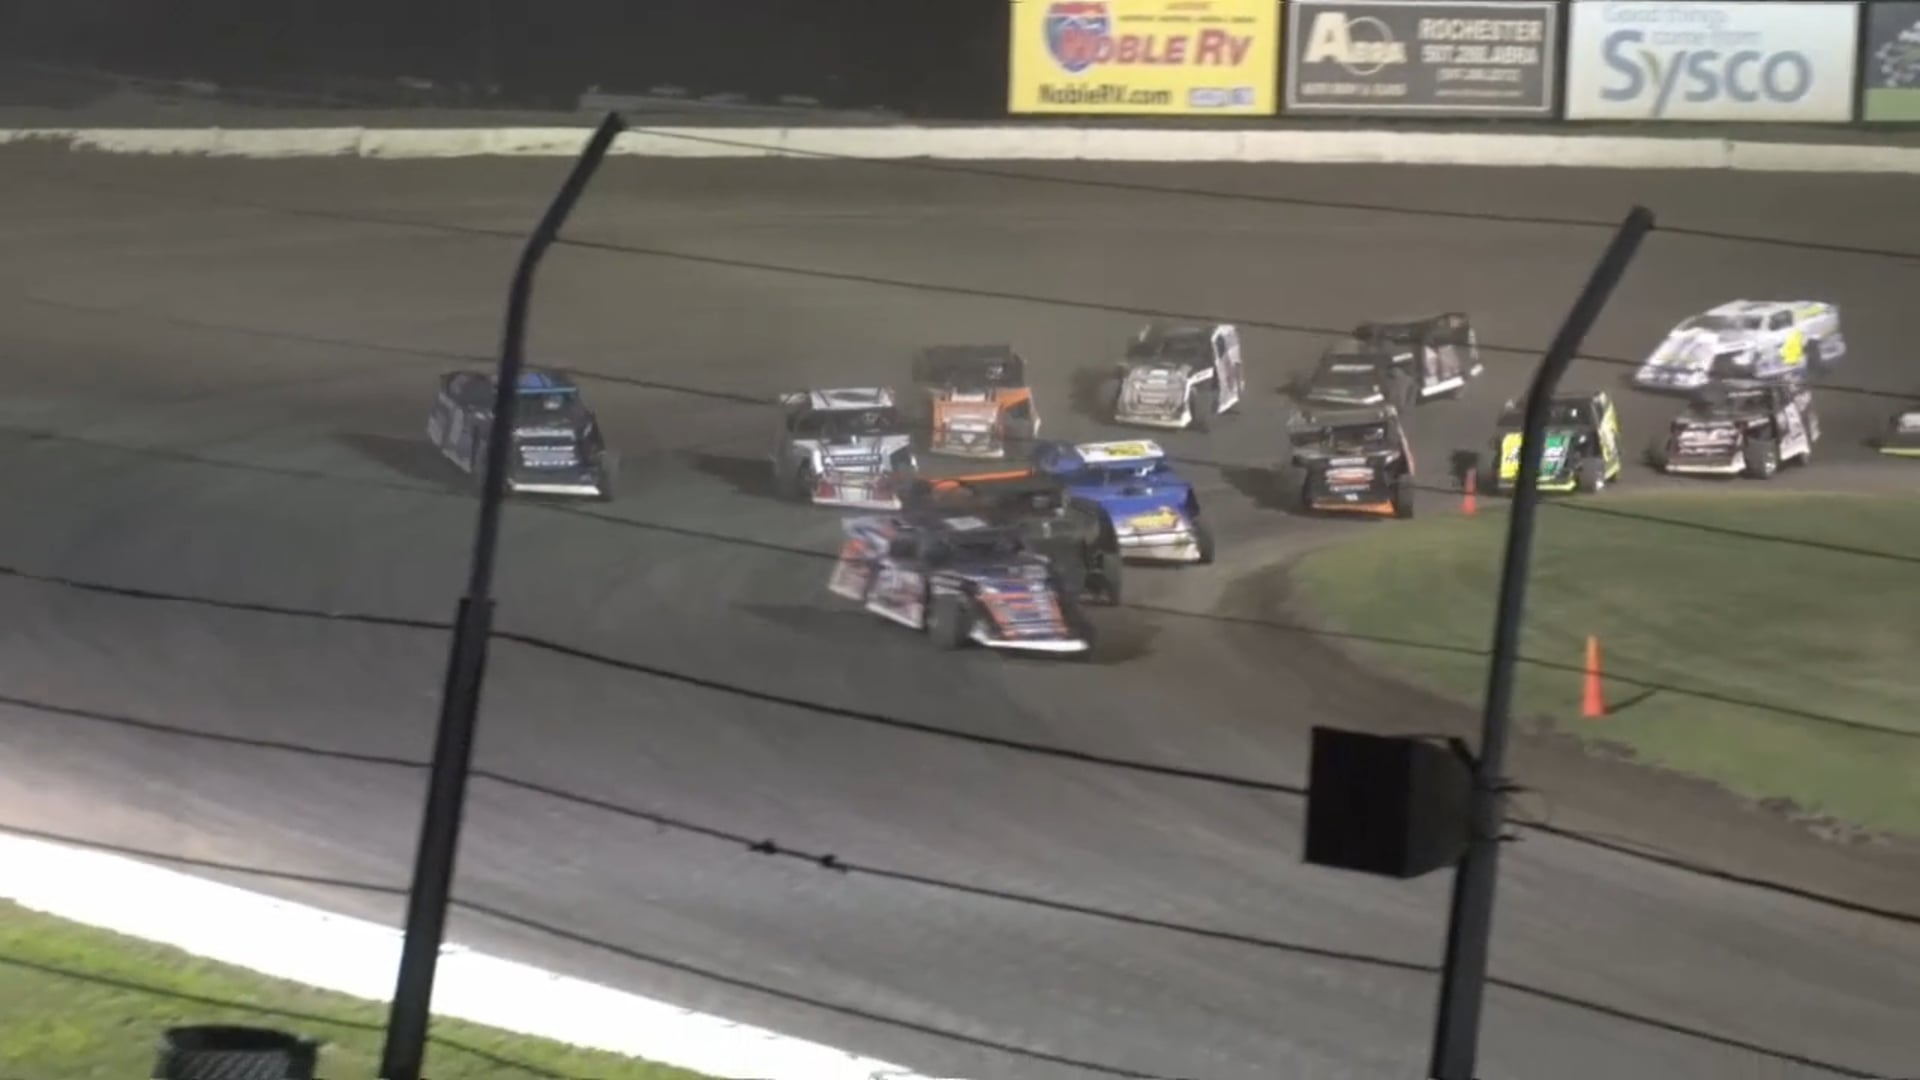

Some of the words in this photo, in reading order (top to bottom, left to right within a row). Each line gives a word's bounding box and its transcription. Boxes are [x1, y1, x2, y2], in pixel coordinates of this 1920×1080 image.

[1418, 18, 1543, 41] ROCHESTER
[1602, 29, 1813, 118] Sysco
[1038, 83, 1170, 105] NobleRV.com
